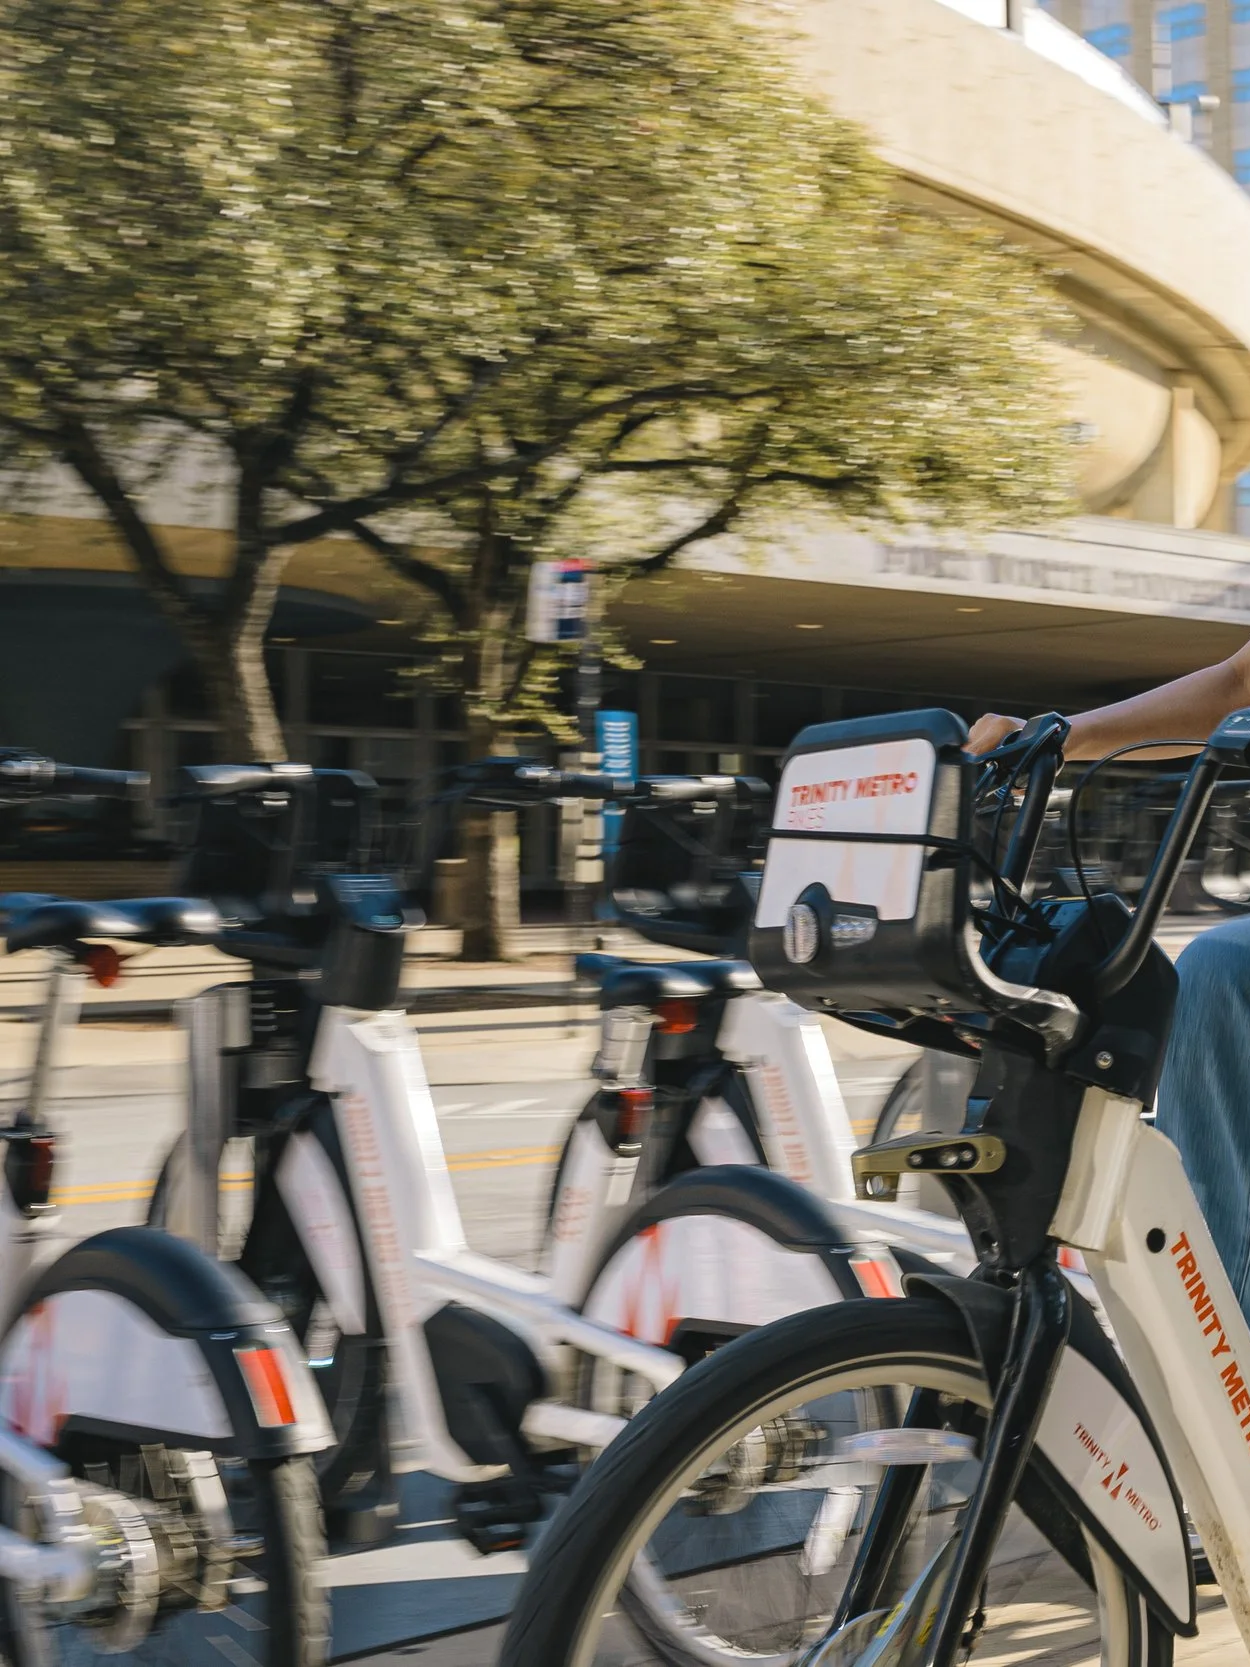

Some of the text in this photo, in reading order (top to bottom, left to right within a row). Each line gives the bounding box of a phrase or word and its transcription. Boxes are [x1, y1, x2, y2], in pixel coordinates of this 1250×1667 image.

[790, 771, 919, 807] TRINITY METRO
[1169, 1231, 1231, 1358] TRINITY
[1073, 1422, 1160, 1532] TRINITY METRO
